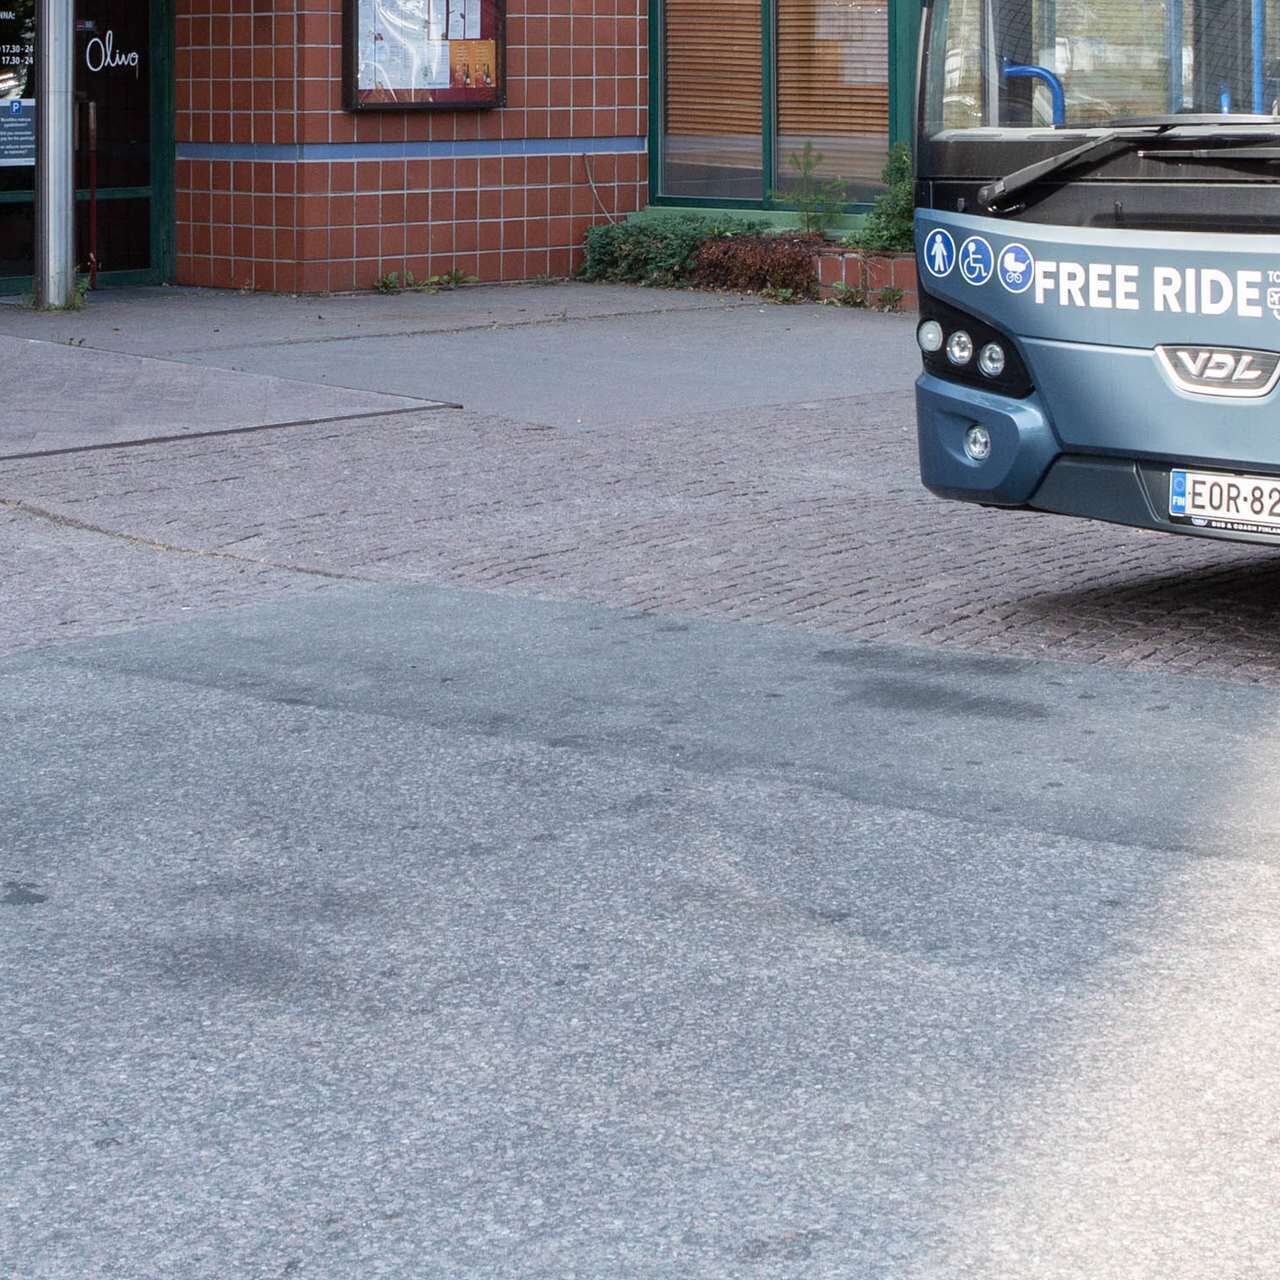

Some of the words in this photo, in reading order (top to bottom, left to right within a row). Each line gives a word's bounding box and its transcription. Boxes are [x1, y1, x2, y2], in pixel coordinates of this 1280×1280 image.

[2, 44, 21, 53] 17.30
[2, 56, 21, 65] 17.30
[86, 30, 139, 71] Olivo
[1035, 260, 1140, 310] FREE
[1153, 266, 1263, 317] RIDE
[1176, 351, 1262, 382] VDL
